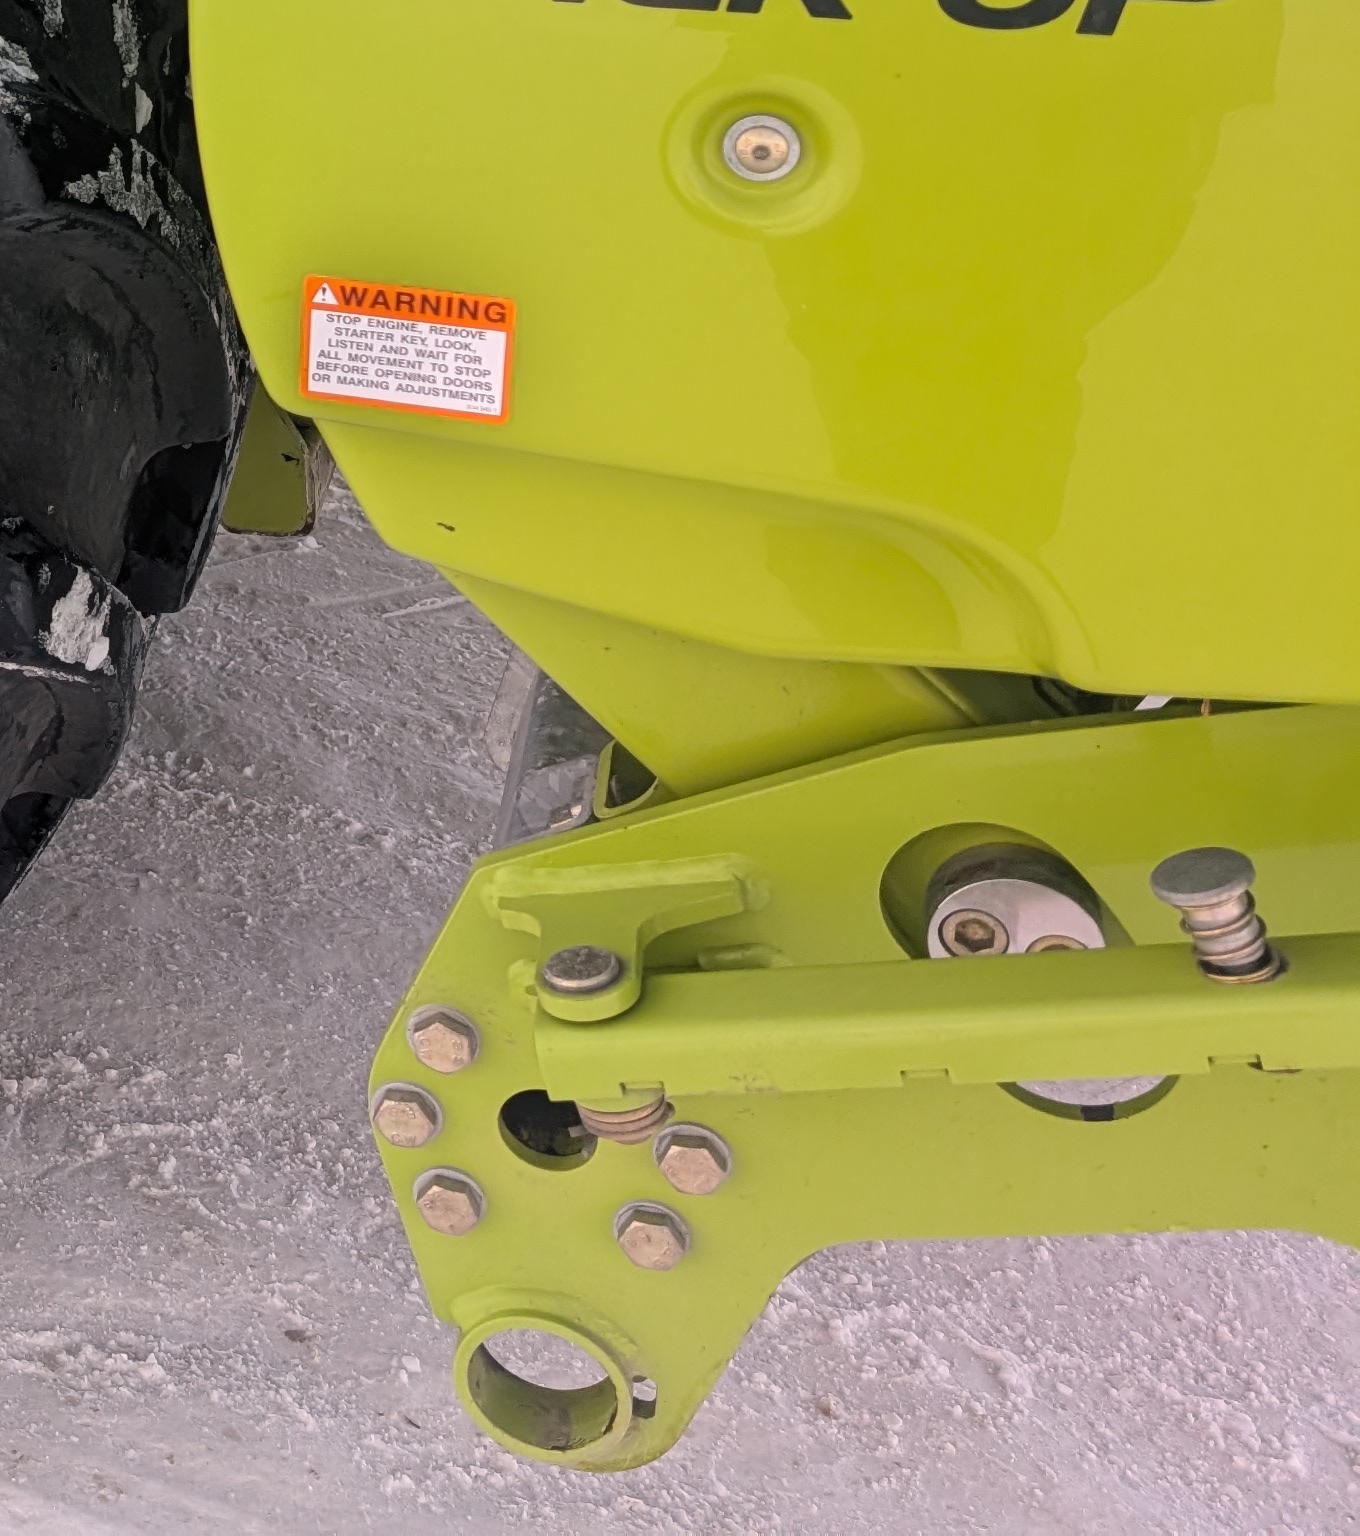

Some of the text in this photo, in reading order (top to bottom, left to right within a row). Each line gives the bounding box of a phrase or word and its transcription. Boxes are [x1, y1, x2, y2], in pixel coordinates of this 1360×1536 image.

[339, 285, 507, 324] WARNING
[326, 314, 361, 325] STOP
[429, 325, 487, 341] REMOVE
[334, 327, 394, 342] STARTER
[435, 338, 476, 353] LOOK,
[318, 349, 491, 378] ALL MOVEMENT TO STOP
[327, 338, 482, 365] LISTEN AND WAIT FOR
[312, 372, 495, 404] OR MAKING ADJUSTMENTS
[316, 361, 492, 392] BEFORE OPENING DOORS
